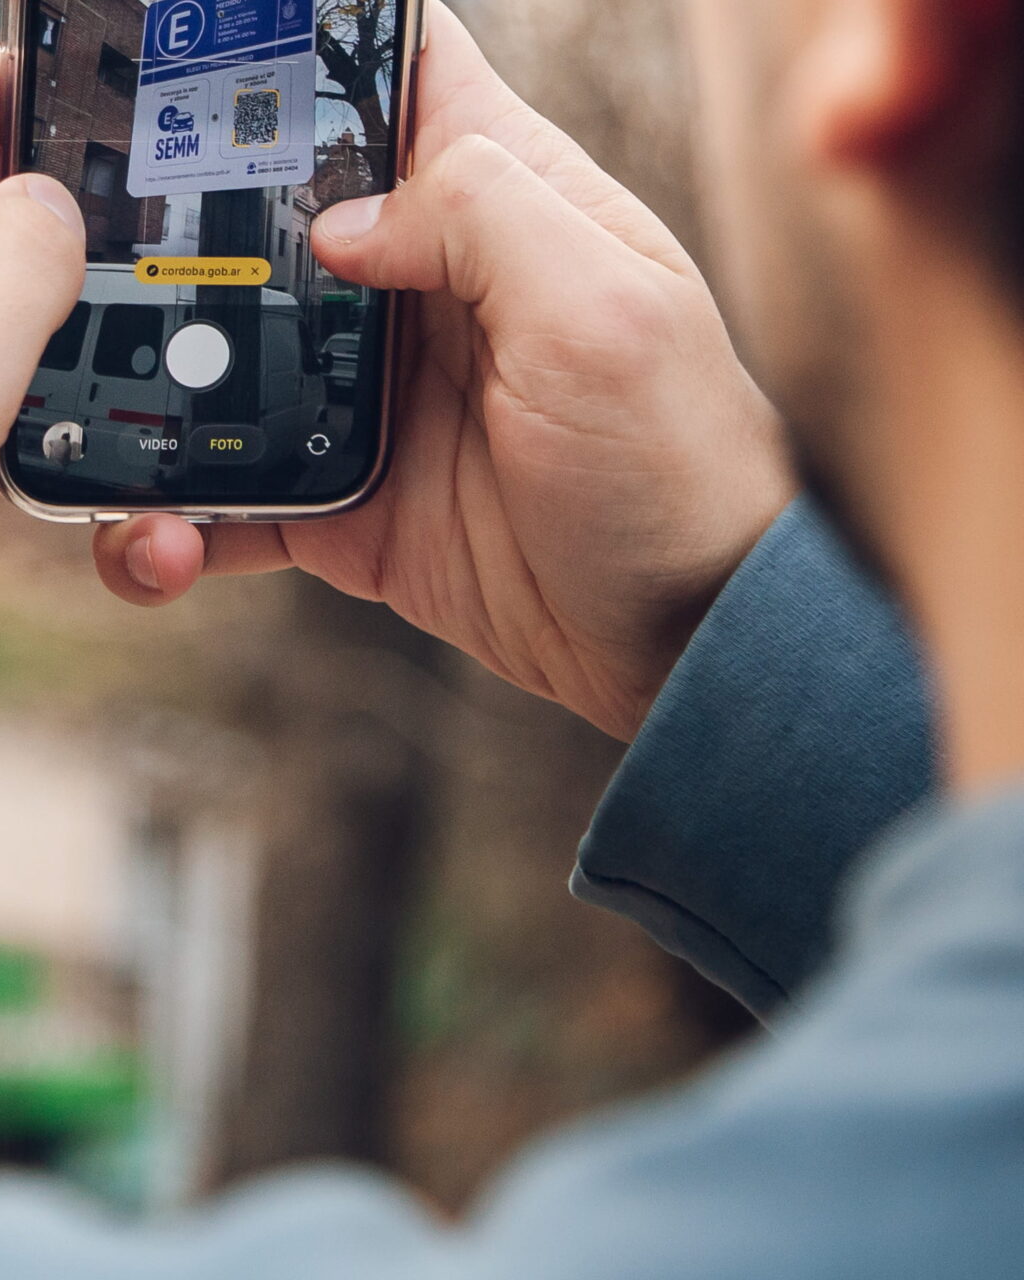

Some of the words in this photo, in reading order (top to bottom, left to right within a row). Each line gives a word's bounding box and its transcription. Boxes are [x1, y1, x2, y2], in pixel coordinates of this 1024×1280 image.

[169, 10, 191, 50] E
[164, 112, 172, 125] E
[155, 133, 200, 161] SEMM
[161, 266, 241, 278] cordoba.gob.ar
[139, 439, 178, 450] VIDEO
[210, 439, 243, 450] FOTO
